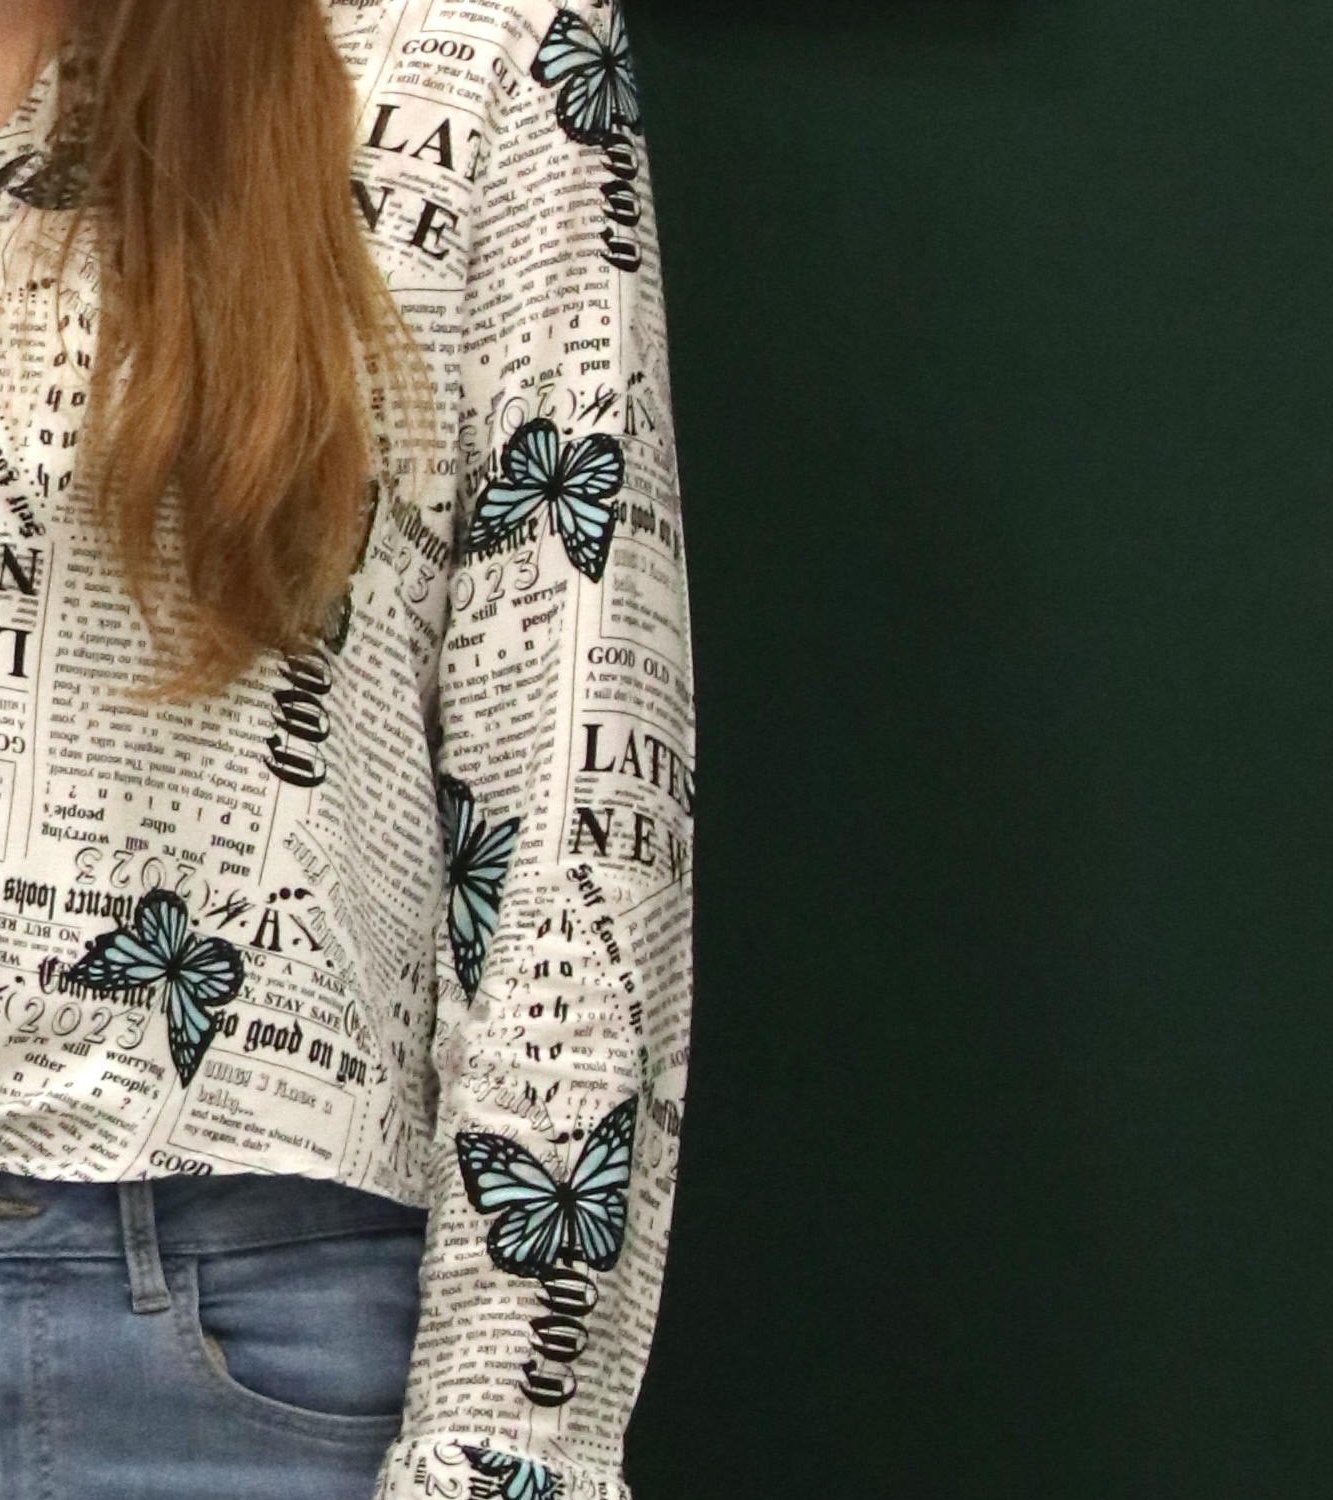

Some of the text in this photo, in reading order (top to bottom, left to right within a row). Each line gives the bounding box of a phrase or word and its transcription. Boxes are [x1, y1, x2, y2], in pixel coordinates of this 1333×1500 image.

[400, 38, 476, 63] GOOD
[564, 337, 611, 355] about
[580, 359, 611, 376] and
[471, 601, 498, 622] still
[447, 631, 486, 651] other
[41, 822, 110, 846] worrying
[43, 802, 256, 857] about other people's
[162, 844, 207, 865] you're
[219, 860, 251, 877] and
[3, 877, 57, 921] looks
[23, 924, 52, 940] BUT
[58, 927, 81, 944] NO
[264, 991, 306, 1013] STAY
[243, 1017, 304, 1056] good
[307, 1037, 335, 1071] on
[23, 1050, 67, 1074] other
[100, 1069, 160, 1101] people's
[105, 1050, 166, 1081] worrying
[267, 1129, 303, 1147] should
